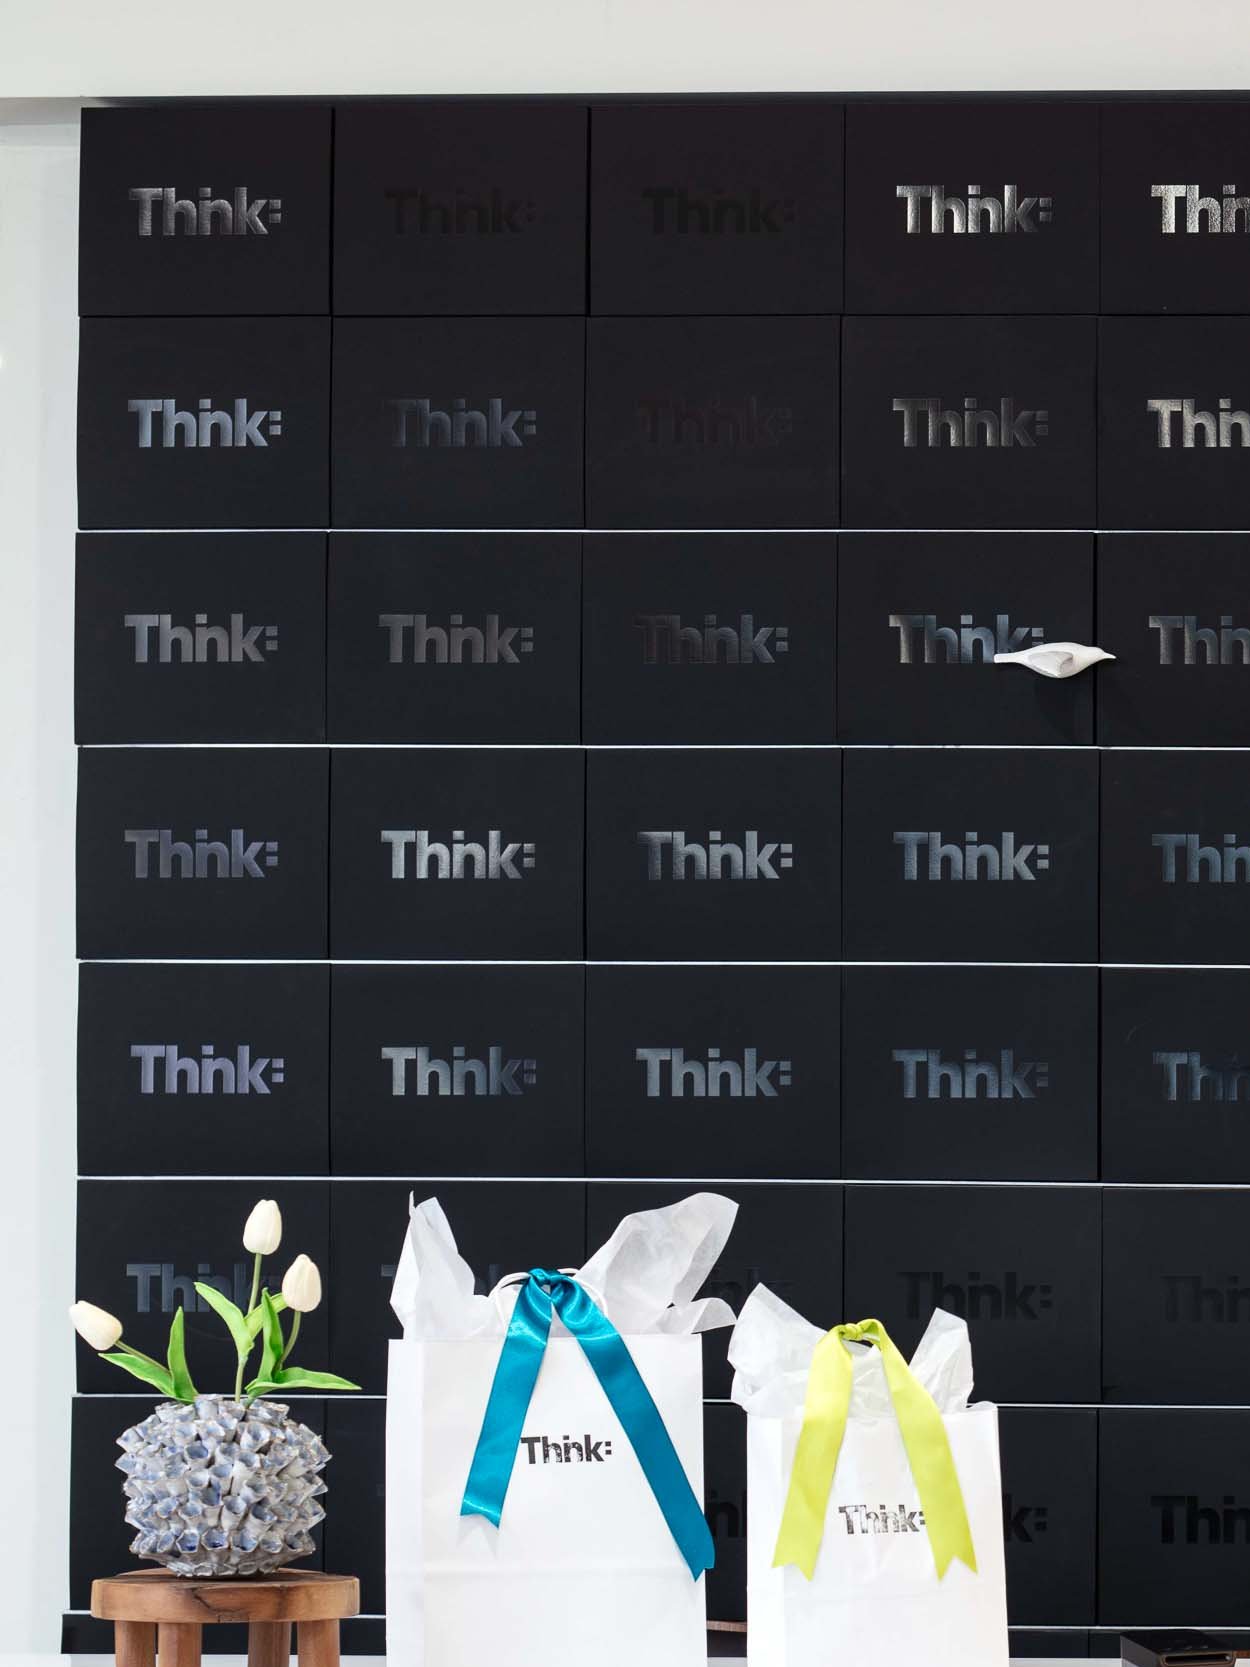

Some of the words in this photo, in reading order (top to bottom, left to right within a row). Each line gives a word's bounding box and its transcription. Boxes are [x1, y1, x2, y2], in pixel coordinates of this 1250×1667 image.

[129, 186, 282, 236] Think:
[384, 187, 536, 234] Think:
[642, 188, 794, 234] Think:
[895, 184, 1052, 234] Think:
[128, 397, 282, 448] Think:
[386, 398, 536, 447] Think:
[640, 397, 793, 446] Think:
[892, 397, 1049, 447] Think:
[124, 613, 278, 664] Think:
[379, 614, 533, 664] Think:
[634, 614, 789, 664] Think:
[125, 829, 278, 878] Think:
[380, 829, 535, 880] Think:
[636, 830, 793, 880] Think:
[894, 831, 1050, 881] Think:
[130, 1044, 284, 1094] Think:
[380, 1046, 536, 1096] Think:
[636, 1047, 792, 1098] Think:
[893, 1048, 1049, 1099] Think:
[897, 1272, 1053, 1319] Think:
[521, 1434, 612, 1464] Think:
[838, 1504, 926, 1535] Think:
